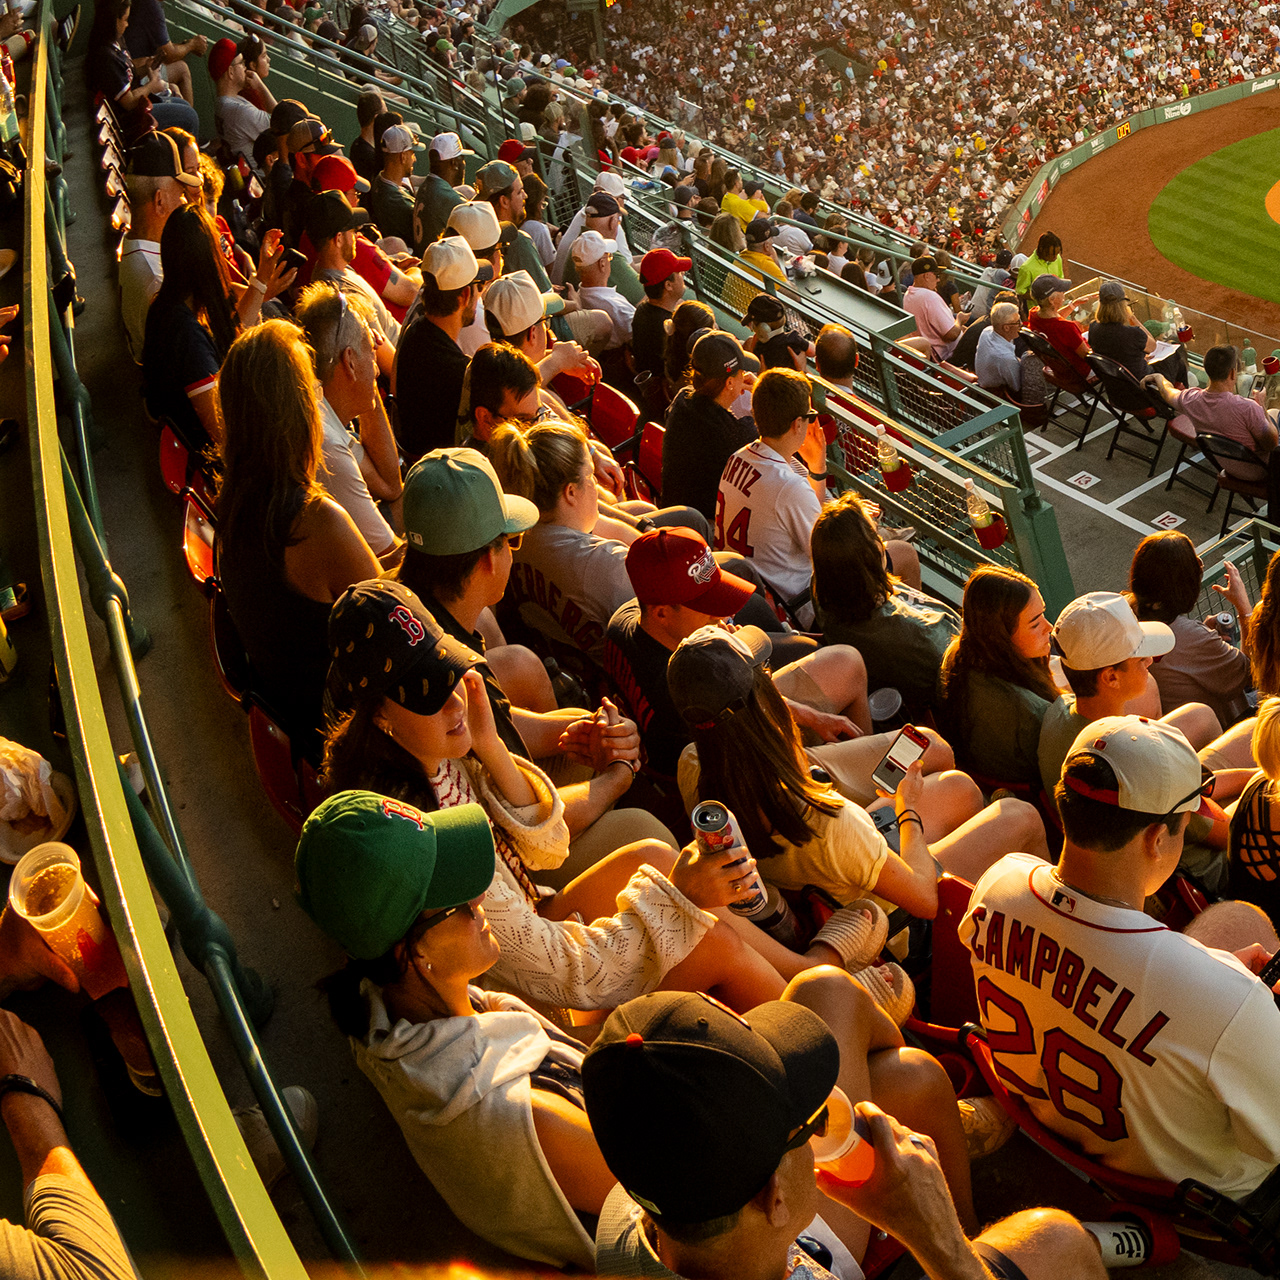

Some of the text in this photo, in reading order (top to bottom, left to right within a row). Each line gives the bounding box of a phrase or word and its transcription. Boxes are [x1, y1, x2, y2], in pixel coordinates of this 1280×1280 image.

[1165, 110, 1180, 119] Nine
[1160, 514, 1178, 525] 12
[388, 605, 425, 647] B
[381, 797, 424, 831] B
[971, 904, 1171, 1068] CAMPBELL
[977, 974, 1129, 1142] 28
